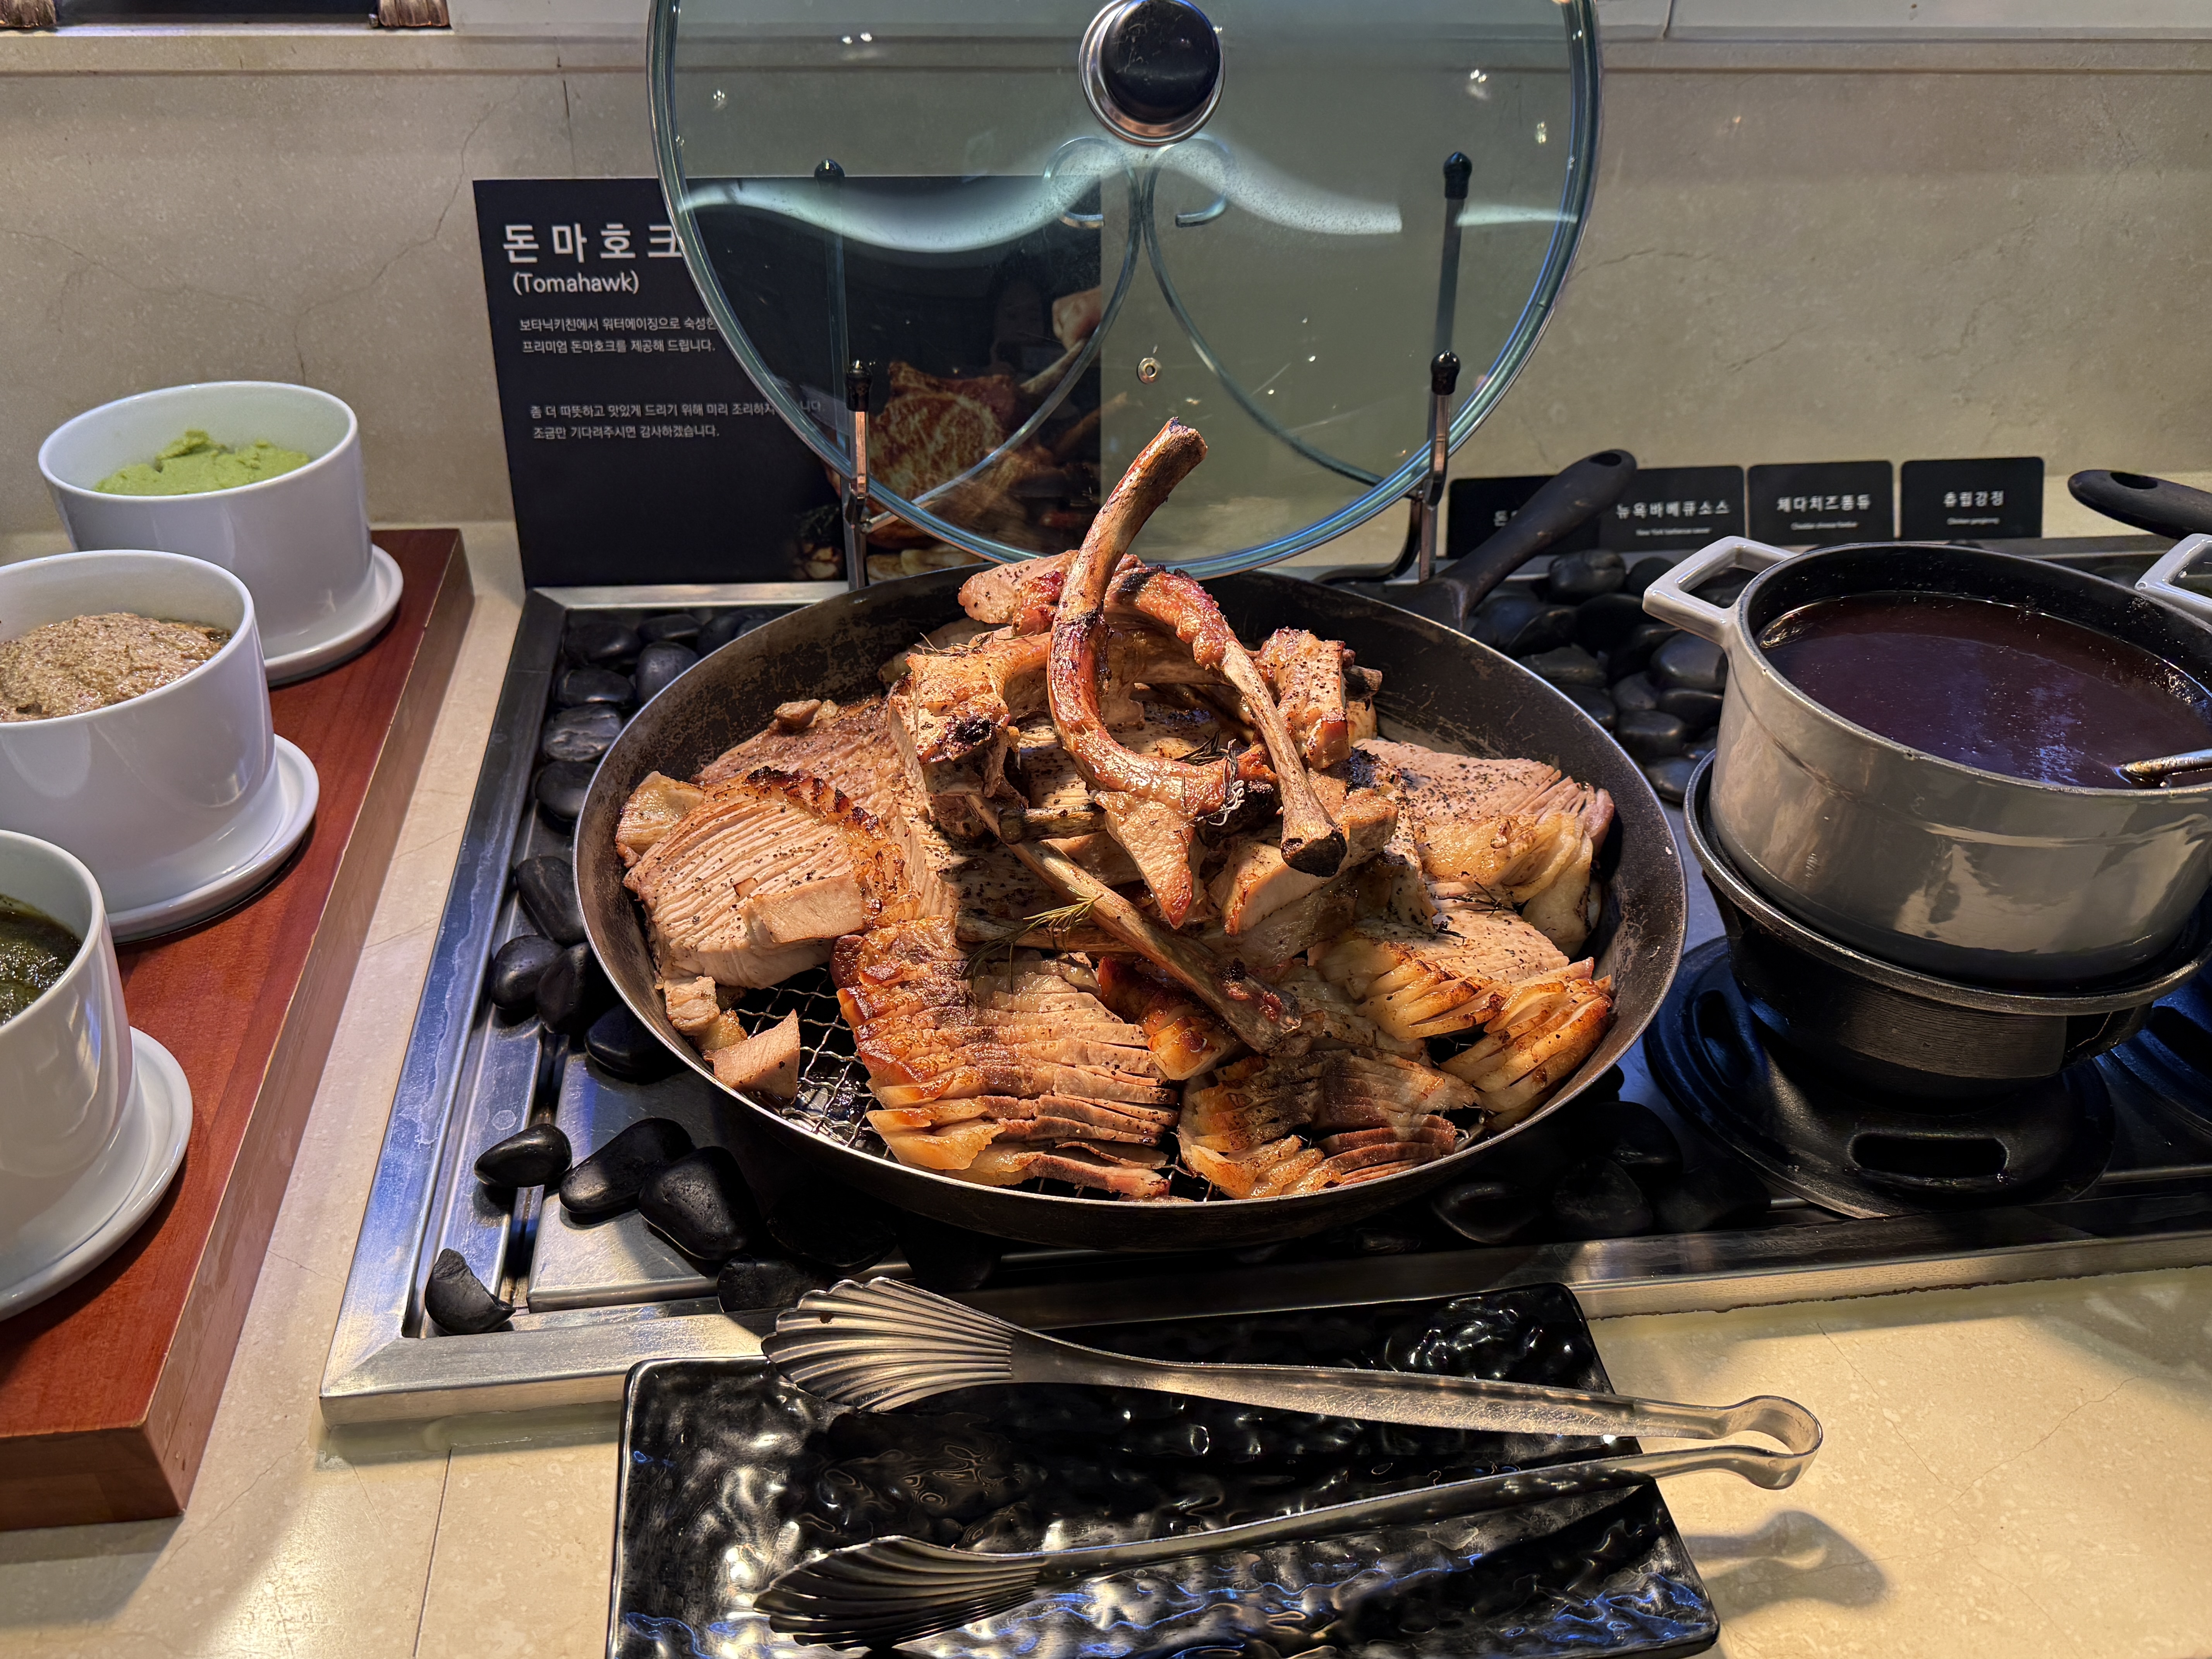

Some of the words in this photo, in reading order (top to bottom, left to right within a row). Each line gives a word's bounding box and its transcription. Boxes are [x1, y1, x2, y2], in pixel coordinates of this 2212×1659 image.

[513, 270, 639, 295] (Tomahawk)
[520, 318, 599, 331] 보타닉키친에서
[603, 317, 681, 331] 워터에이징으로
[523, 340, 568, 354] 프리미엄
[571, 340, 626, 353] 돈마호크를
[631, 339, 665, 353] 제공해
[668, 339, 715, 352] 드립니다.
[545, 405, 556, 418] 더
[608, 404, 641, 417] 맛있게
[645, 404, 678, 417] 드리기
[681, 404, 704, 416] 위해
[706, 403, 728, 416] 미리
[534, 427, 566, 440] 조금만
[571, 426, 636, 439] 기다려주시면
[640, 425, 720, 438] 감사하겠습니다.
